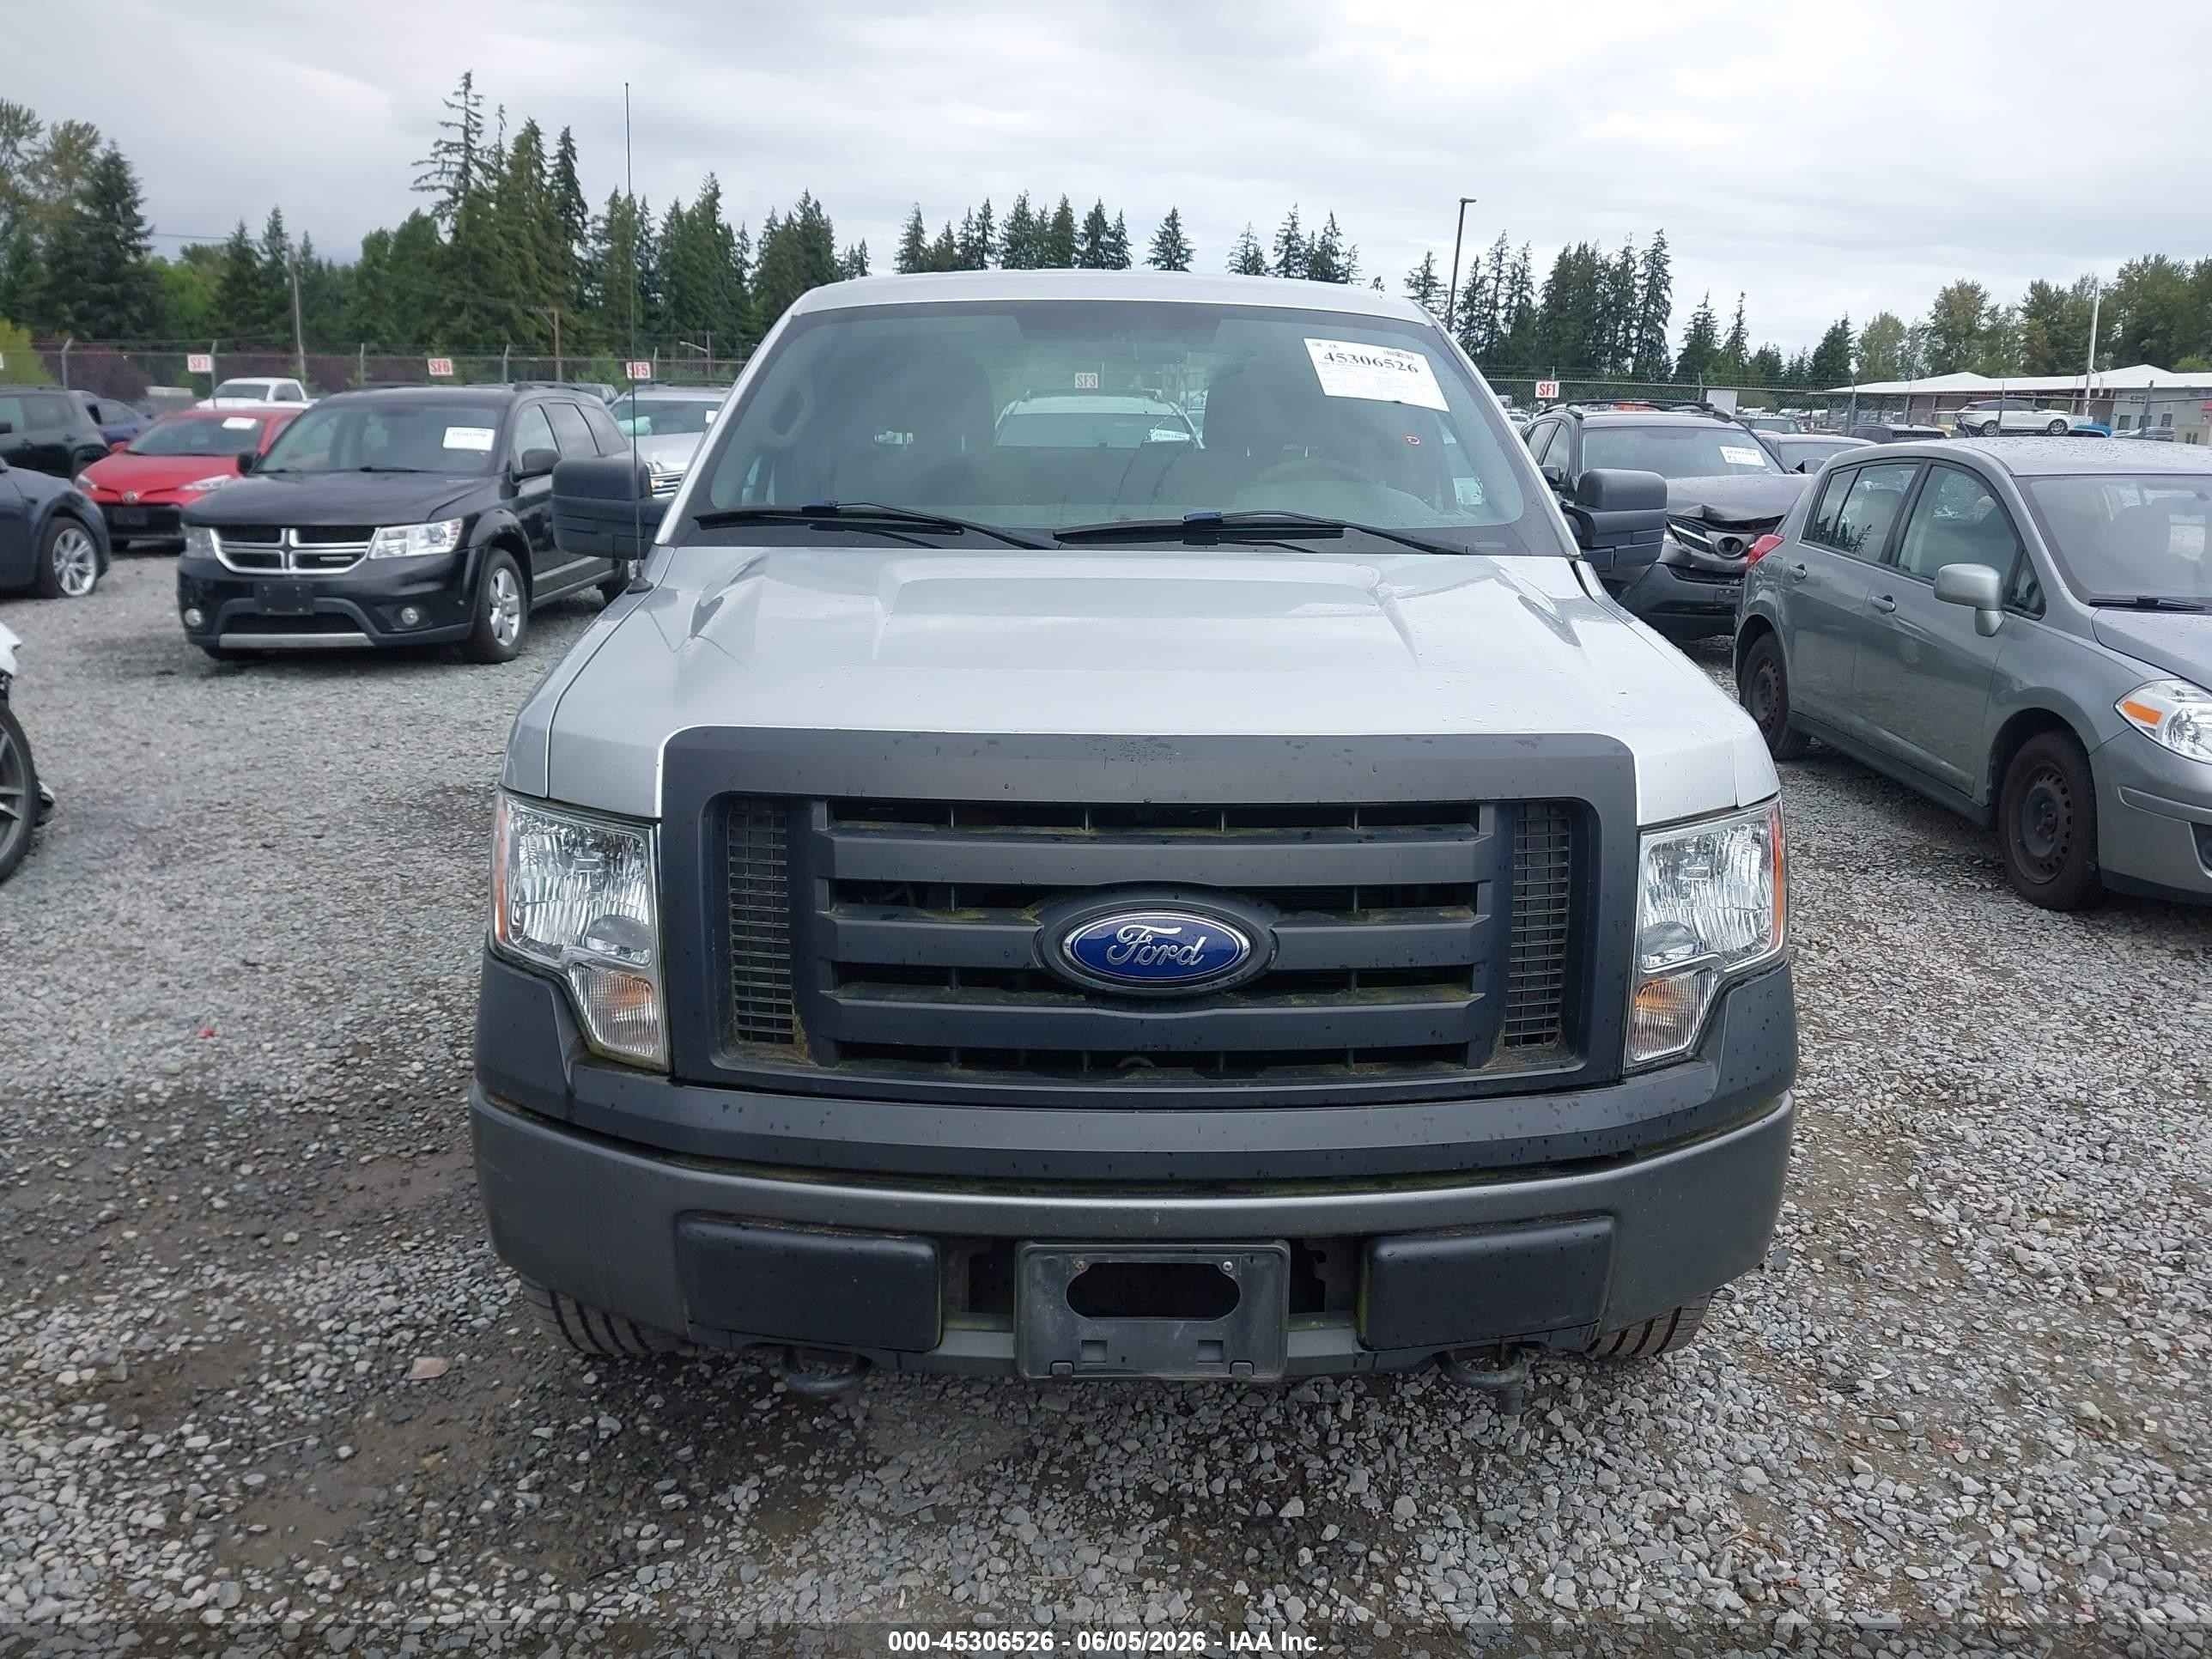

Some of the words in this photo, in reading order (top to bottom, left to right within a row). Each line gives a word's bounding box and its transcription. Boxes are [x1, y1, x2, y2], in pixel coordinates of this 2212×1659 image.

[429, 359, 451, 374] SF6
[627, 362, 648, 376] SF5
[1323, 350, 1419, 374] 45306526
[1077, 374, 1096, 386] SF3
[1539, 383, 1556, 396] SF1
[1106, 923, 1207, 967] Ford
